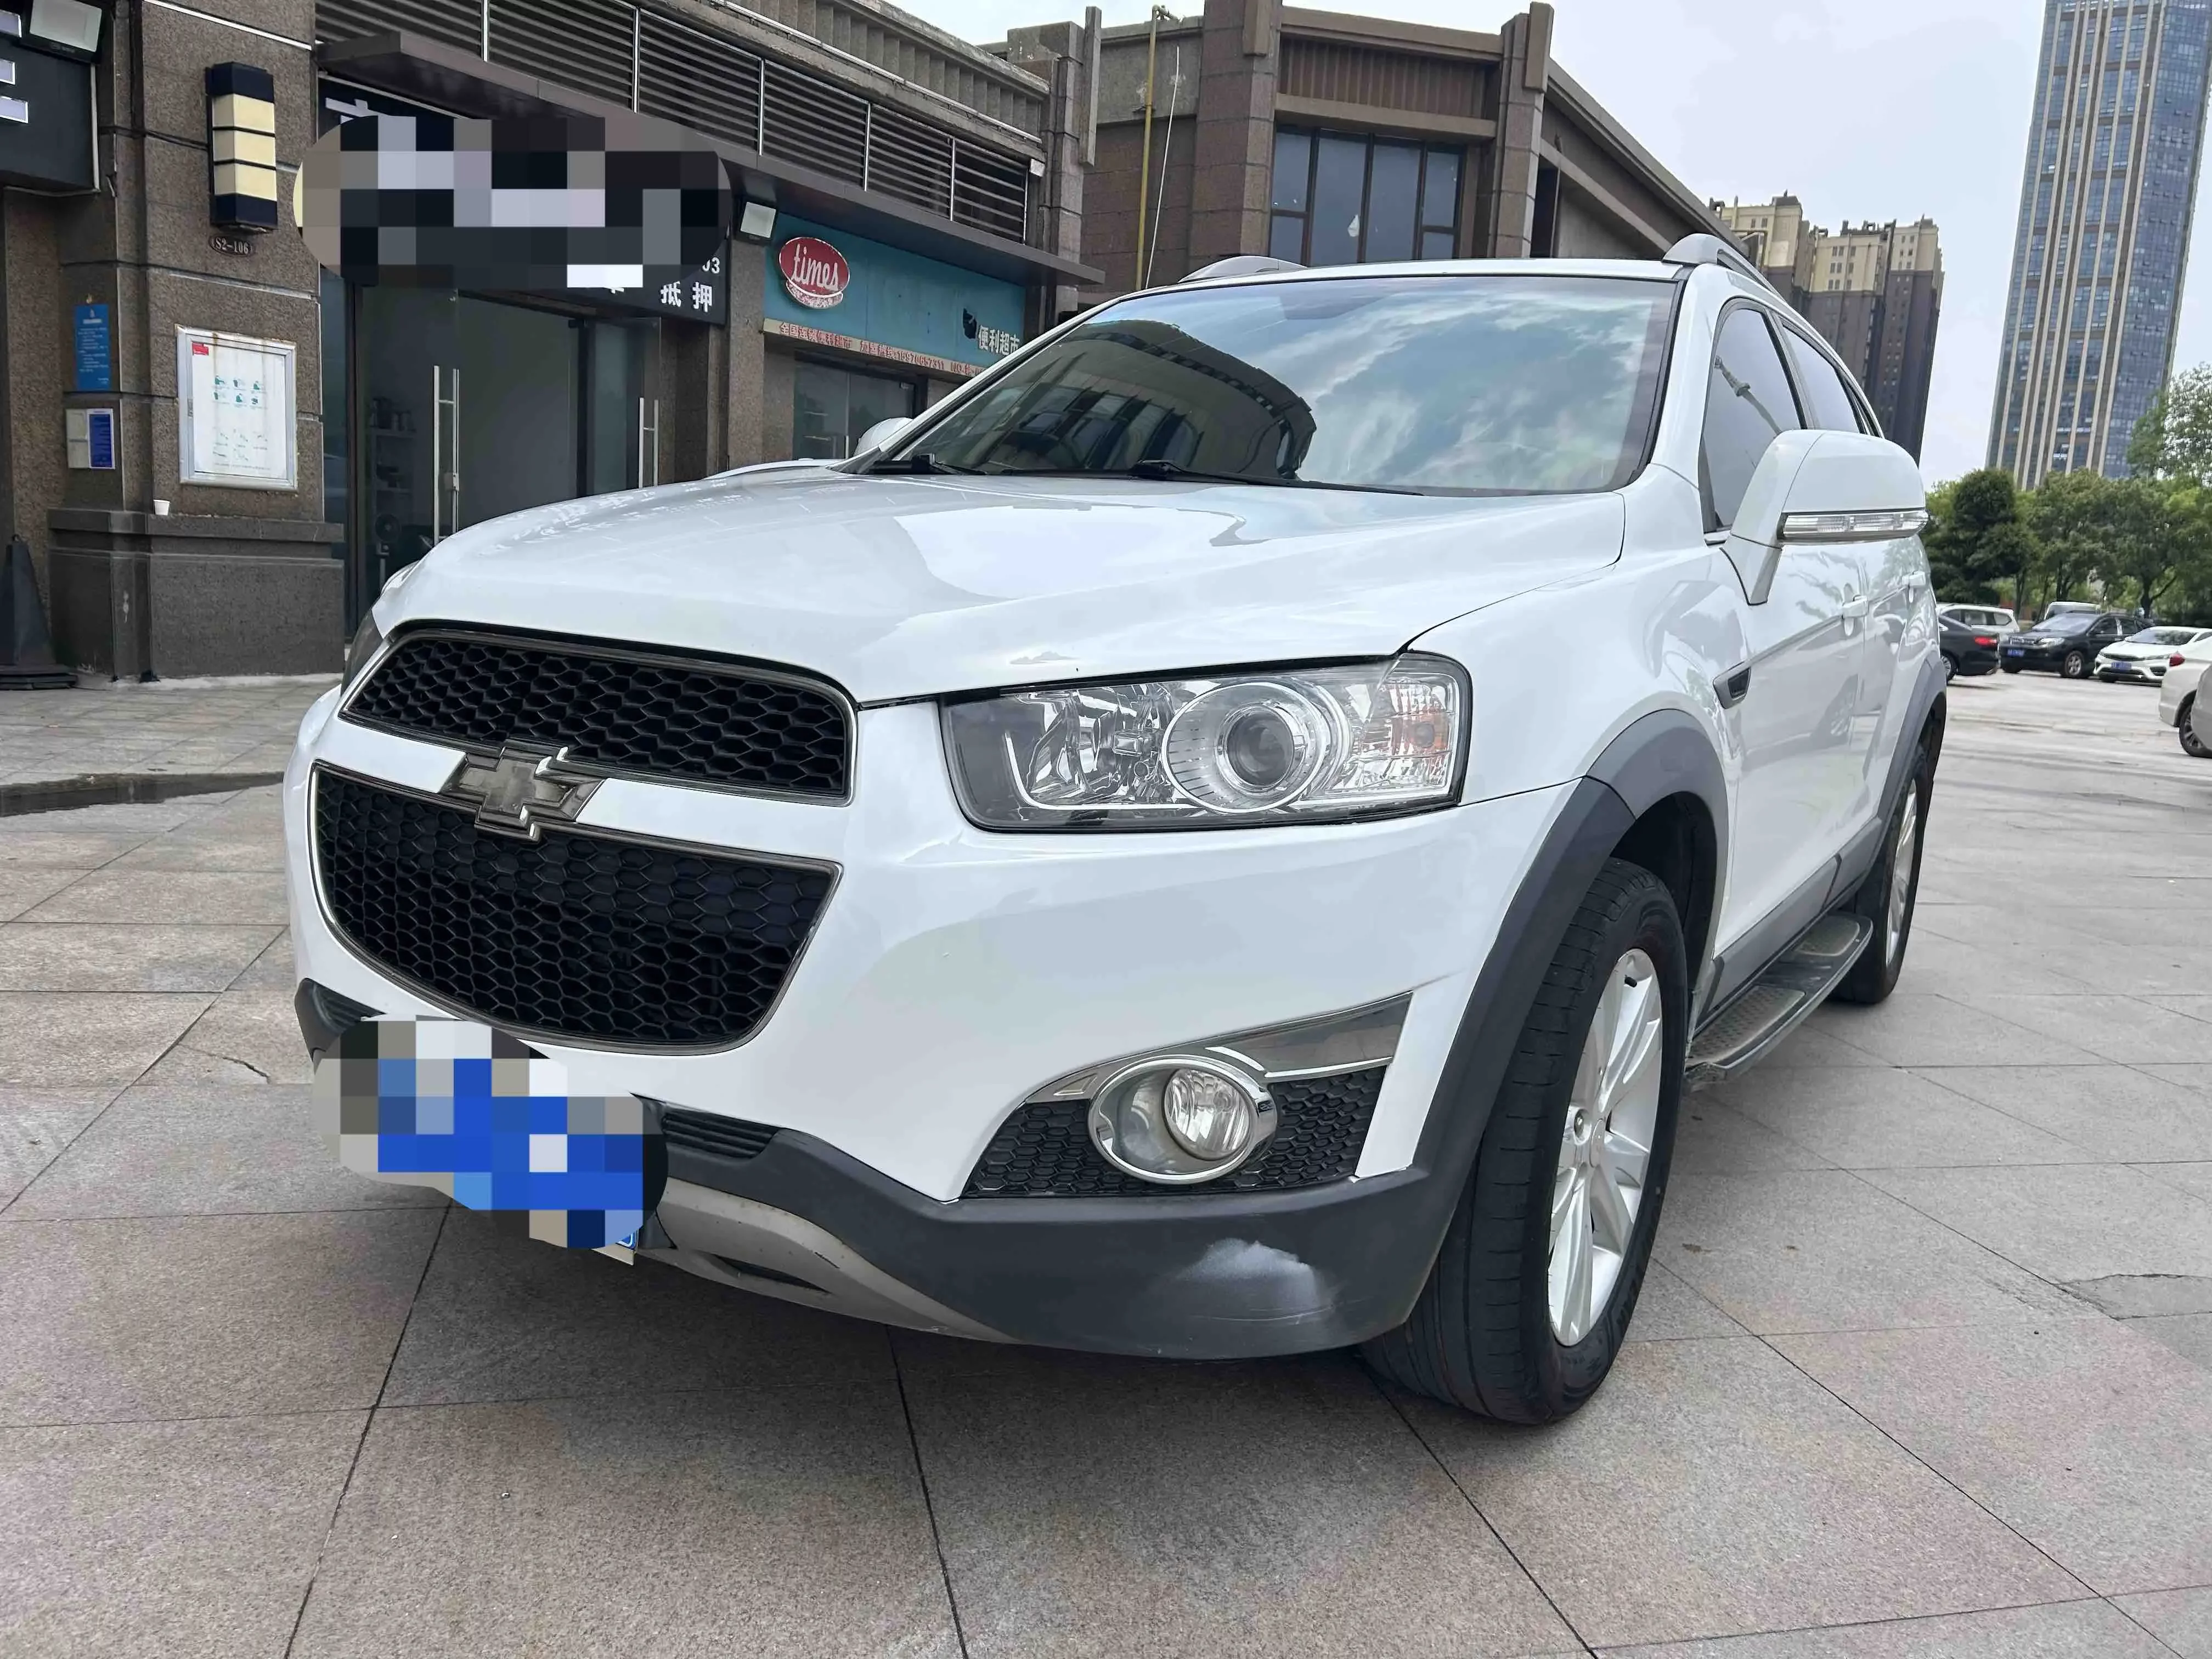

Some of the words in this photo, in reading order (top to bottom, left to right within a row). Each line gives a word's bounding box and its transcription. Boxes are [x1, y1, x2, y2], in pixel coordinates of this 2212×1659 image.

[215, 237, 249, 255] S2-106
[791, 243, 839, 292] times
[978, 325, 1020, 356] 便利超市
